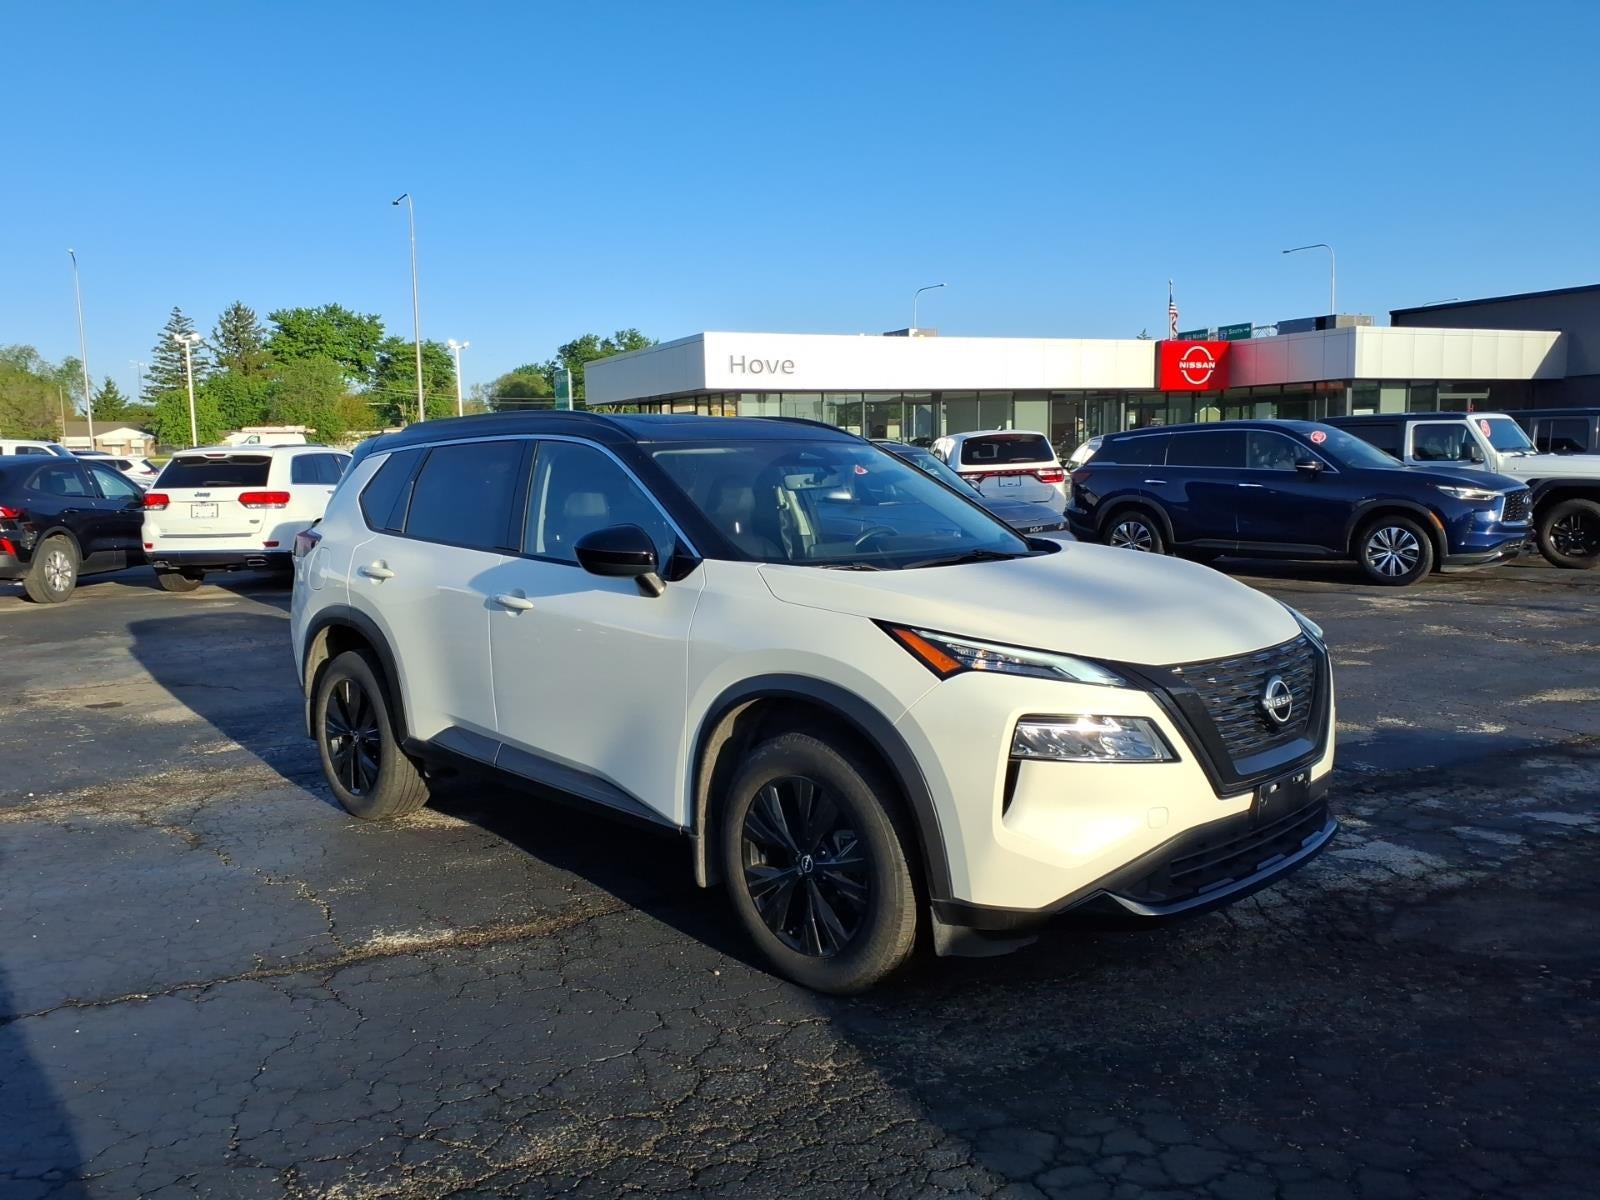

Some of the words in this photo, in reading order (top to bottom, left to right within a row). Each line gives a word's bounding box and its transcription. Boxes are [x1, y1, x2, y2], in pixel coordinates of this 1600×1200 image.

[729, 355, 795, 375] Hove
[1179, 361, 1216, 370] NISSAN
[1266, 694, 1293, 708] NISSAN
